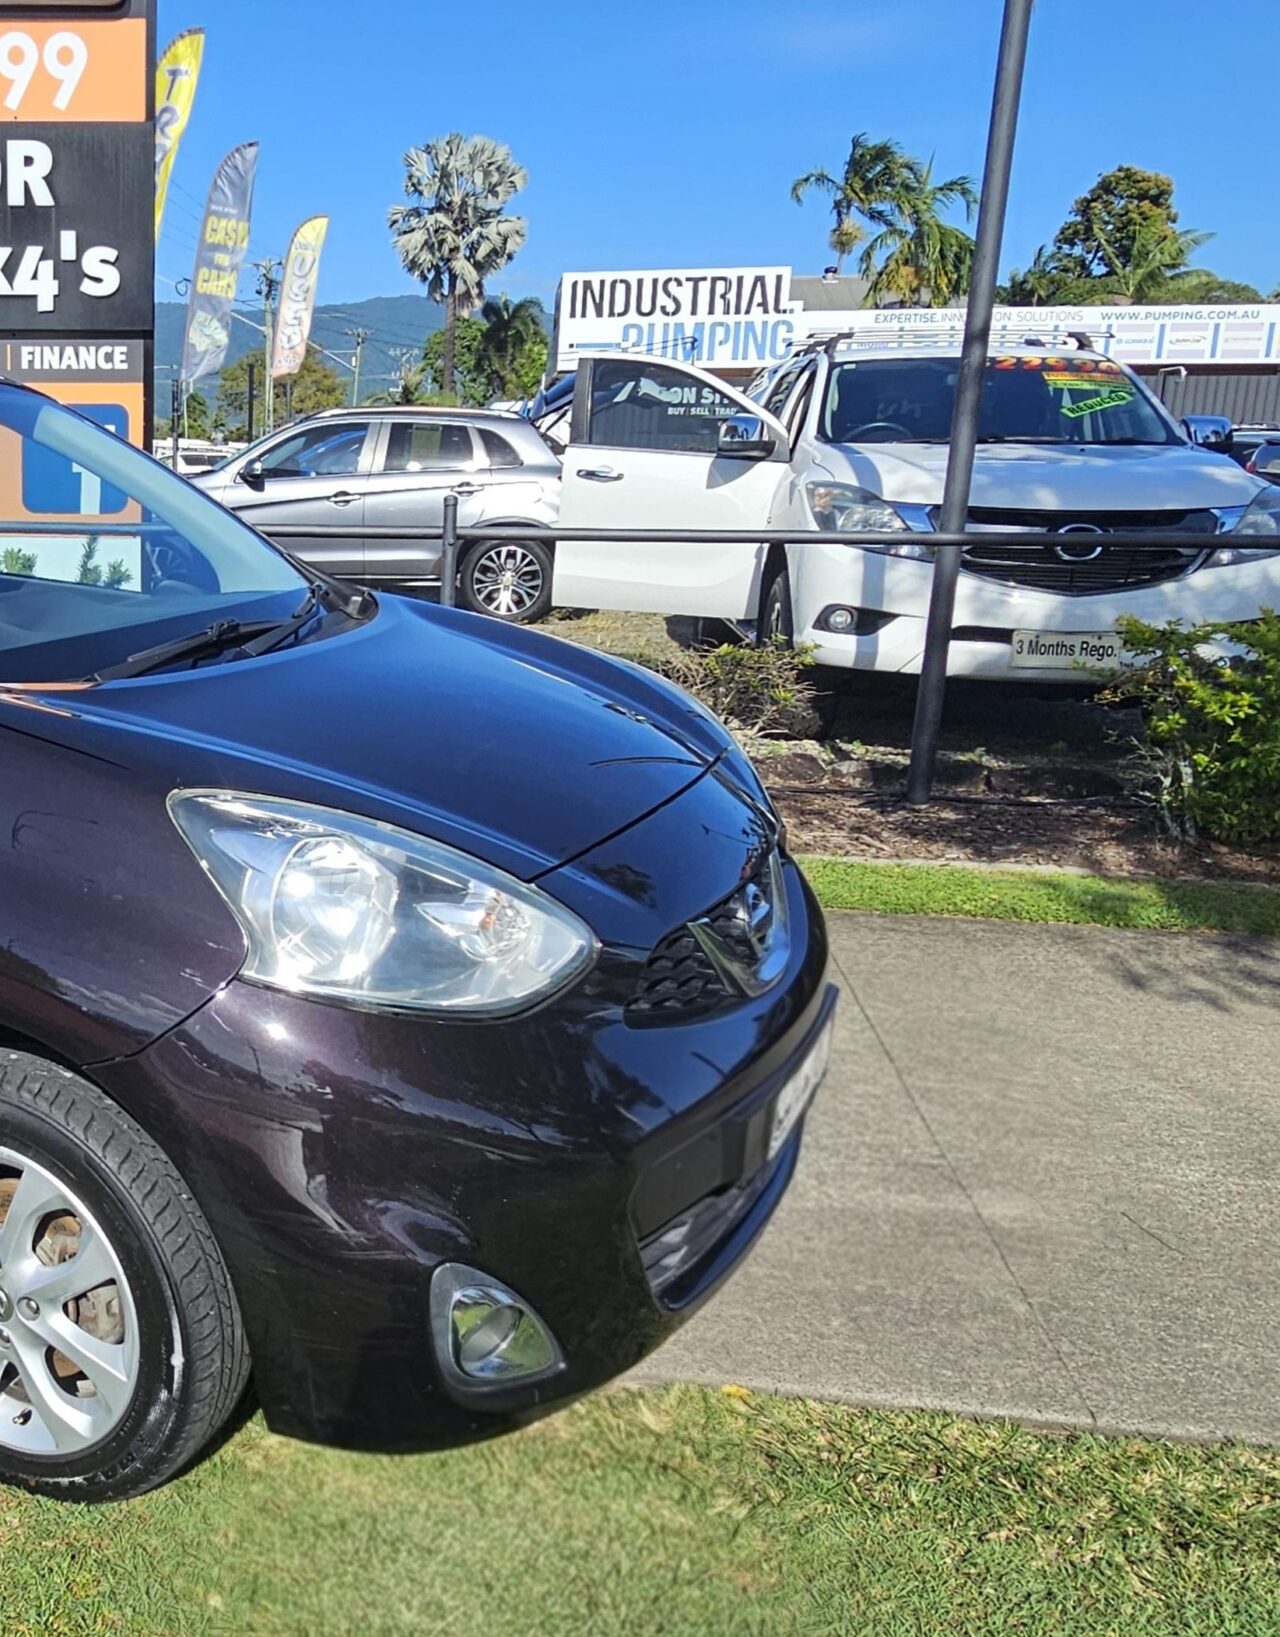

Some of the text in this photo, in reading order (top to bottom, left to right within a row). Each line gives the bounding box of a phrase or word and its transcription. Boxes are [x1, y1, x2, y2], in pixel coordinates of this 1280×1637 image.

[569, 274, 794, 319] INDUSTRIAL
[1017, 310, 1084, 322] SOLUTIONS
[1101, 310, 1260, 321] WWW.PUMPING.COM.AU
[20, 345, 128, 369] FINANCE
[667, 407, 686, 415] BUY
[690, 407, 709, 415] SELL
[1067, 393, 1127, 415] REDUCED
[1016, 639, 1117, 661] 3 Months Rego.
